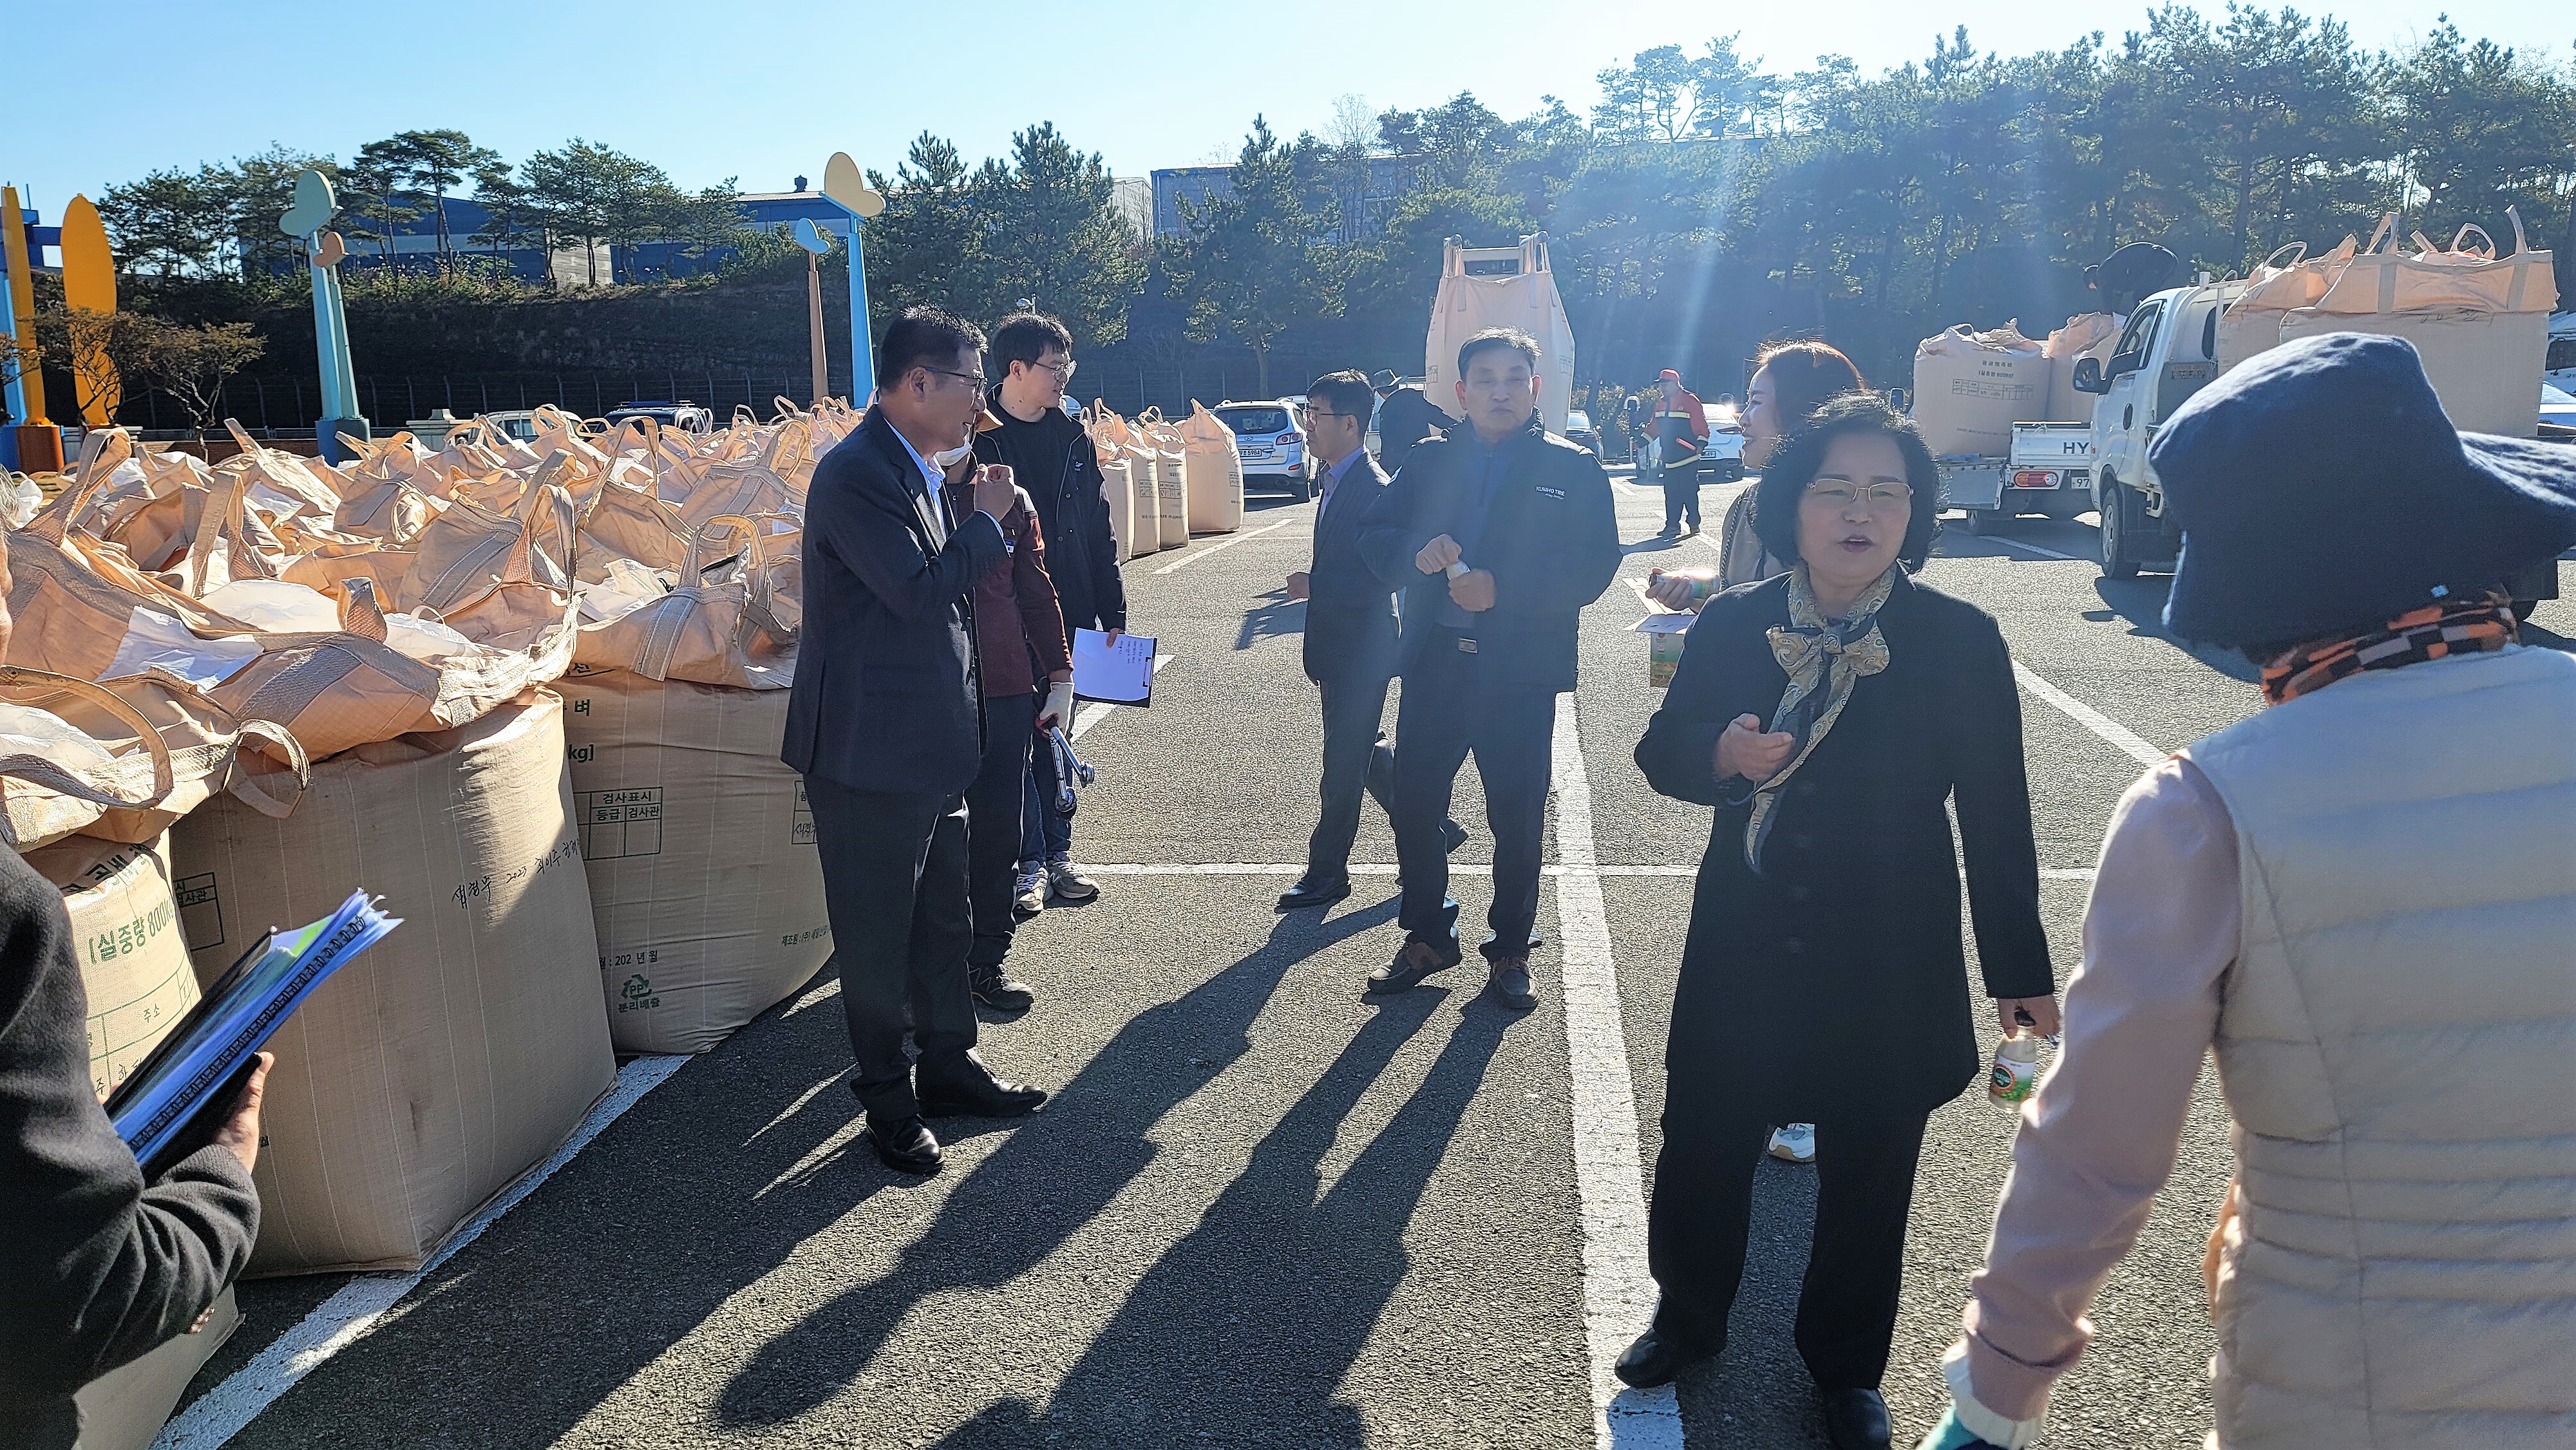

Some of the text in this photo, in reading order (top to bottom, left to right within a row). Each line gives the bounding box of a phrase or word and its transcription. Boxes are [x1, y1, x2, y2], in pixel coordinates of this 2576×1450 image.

[2063, 442, 2090, 454] HY
[2077, 478, 2089, 487] 97
[574, 699, 590, 717] 벼
[568, 744, 594, 763] kg]
[603, 790, 652, 804] 검사표시
[596, 806, 659, 821] 등급 검사관
[615, 954, 631, 966] 202
[637, 952, 645, 965] 년
[630, 984, 643, 994] PP
[143, 1003, 160, 1023] 주소
